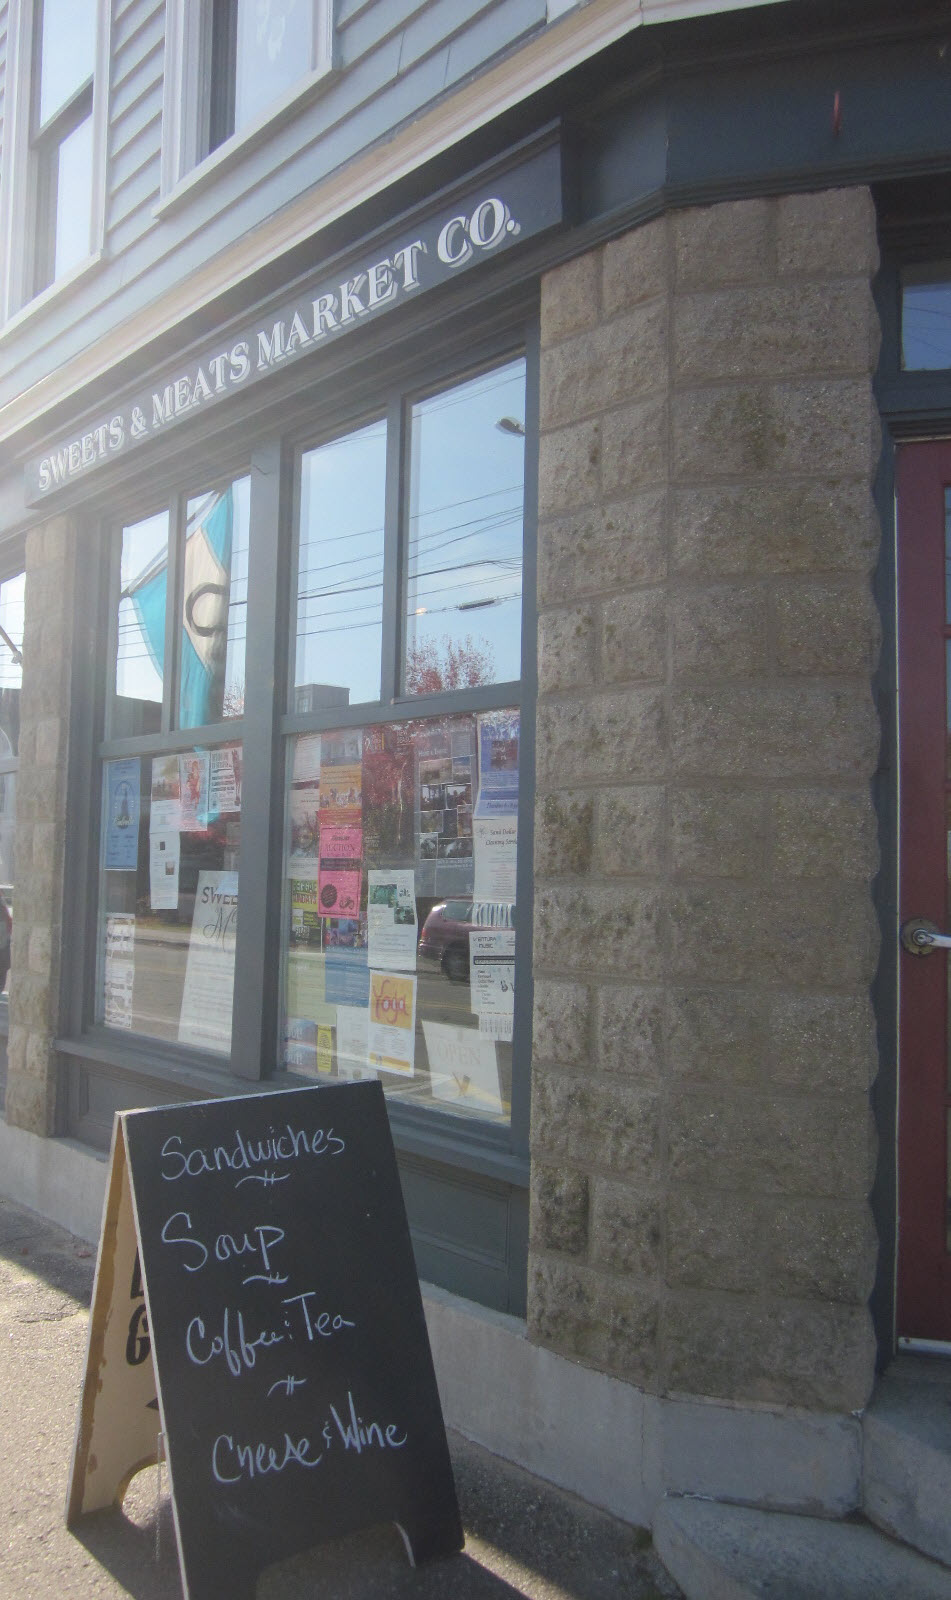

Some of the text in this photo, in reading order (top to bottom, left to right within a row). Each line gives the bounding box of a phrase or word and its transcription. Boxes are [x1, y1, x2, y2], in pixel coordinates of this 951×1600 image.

[38, 197, 521, 491] SWEETS & MEATS MARKET CO.
[372, 978, 410, 1024] Yoga
[161, 1125, 345, 1181] Sandwiches
[161, 1211, 285, 1272] Soup
[186, 1306, 280, 1377] Coffee
[282, 1291, 355, 1342] Tea
[212, 1433, 324, 1484] Cheese
[329, 1391, 407, 1454] Wine
